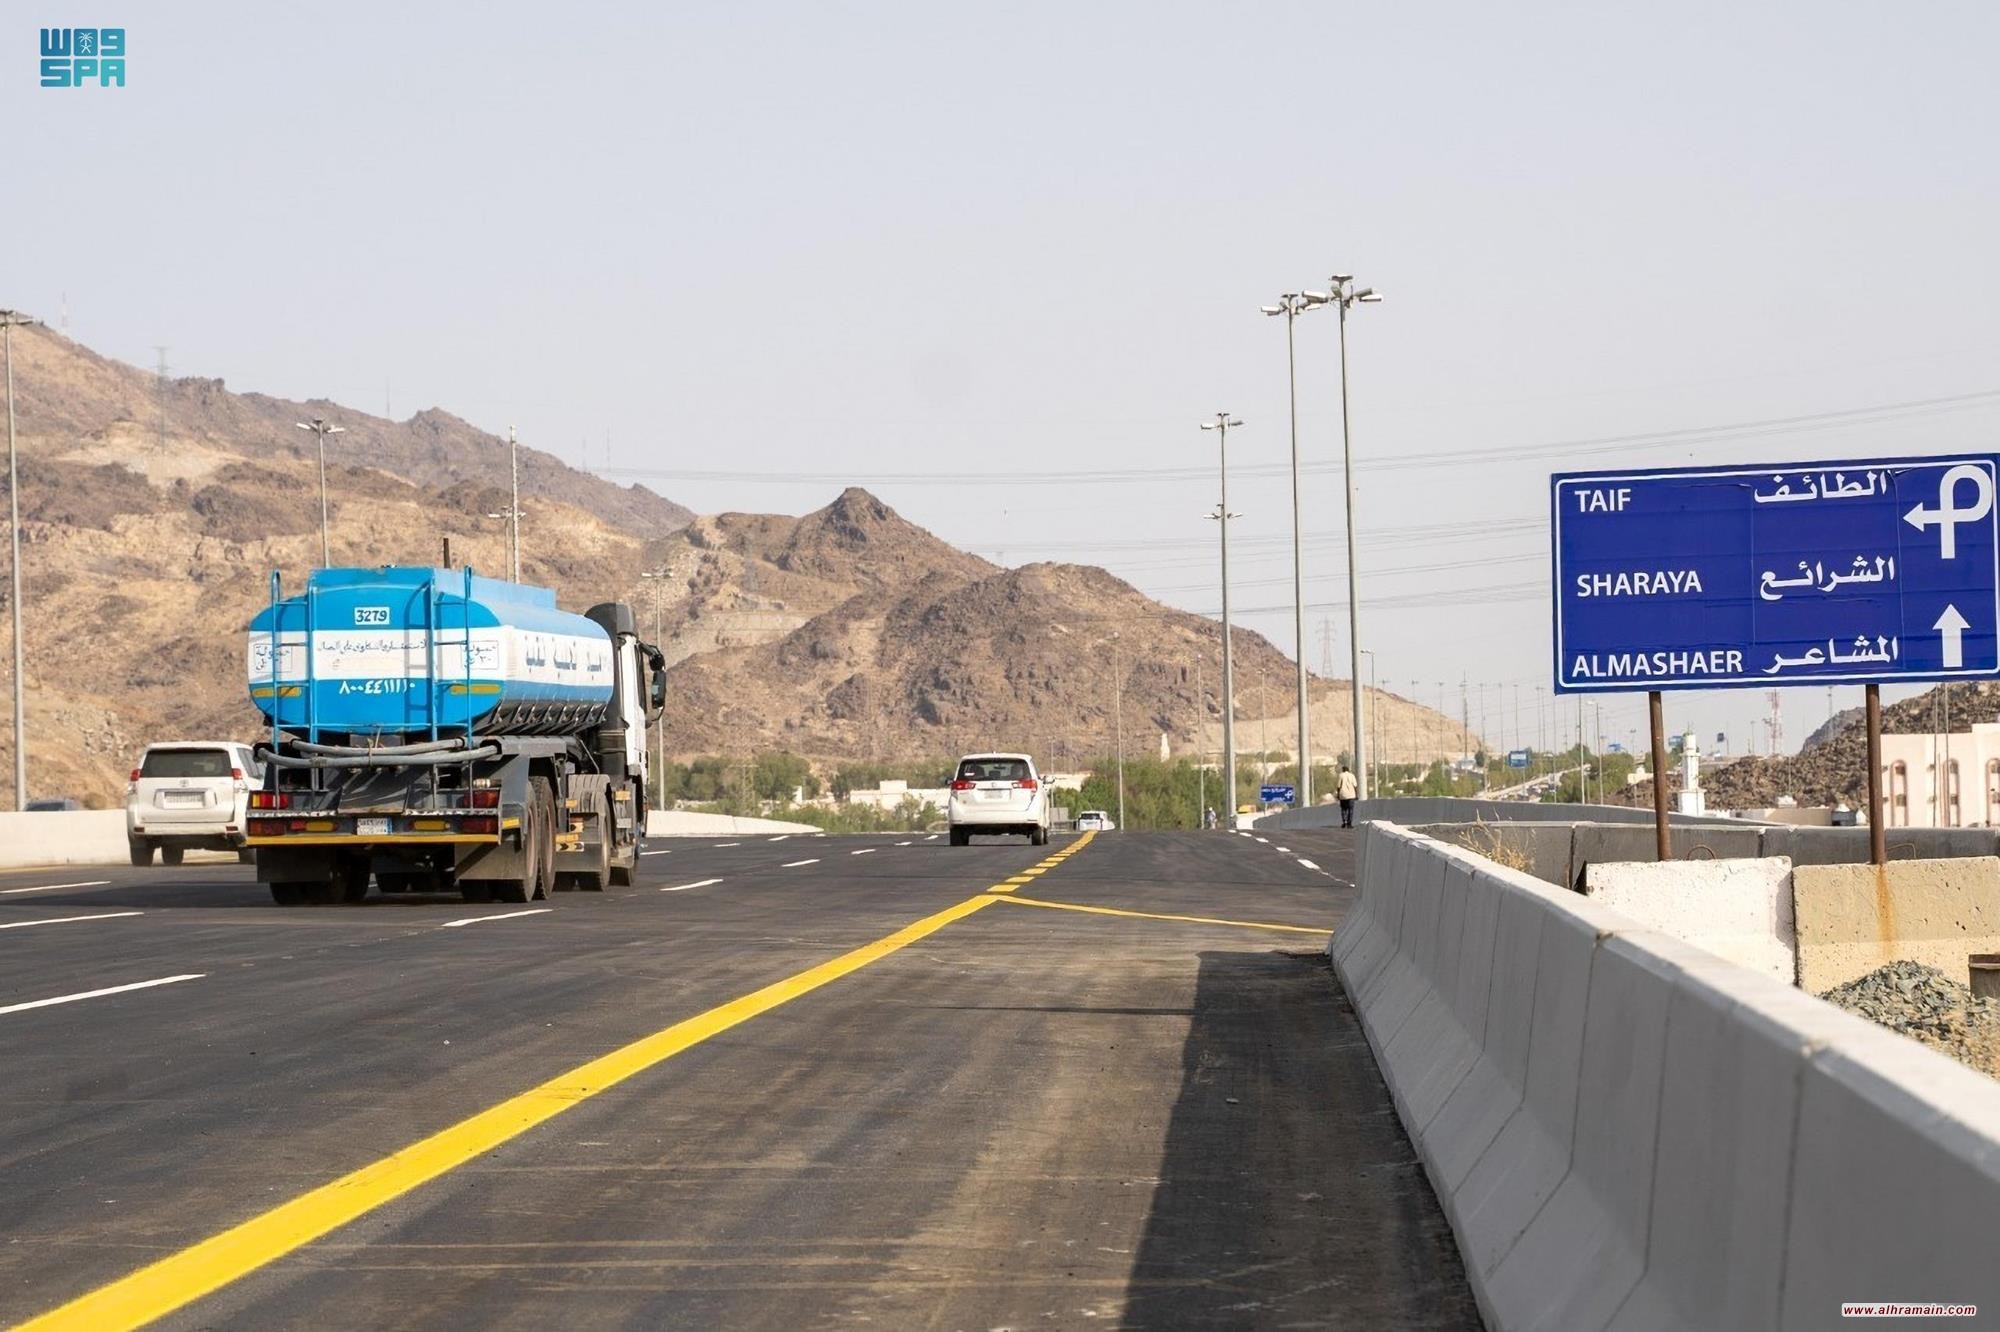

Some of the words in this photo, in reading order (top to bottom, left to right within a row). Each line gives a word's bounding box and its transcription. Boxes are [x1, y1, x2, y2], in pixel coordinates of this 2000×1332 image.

[1754, 470, 1888, 503] الطائف
[1574, 489, 1632, 513] TAIF
[1577, 570, 1703, 597] SHARAYA
[1760, 555, 1896, 601] الشرائع
[356, 609, 388, 623] 3279
[1572, 650, 1744, 678] ALMASHAER
[1761, 634, 1899, 675] المشاعر
